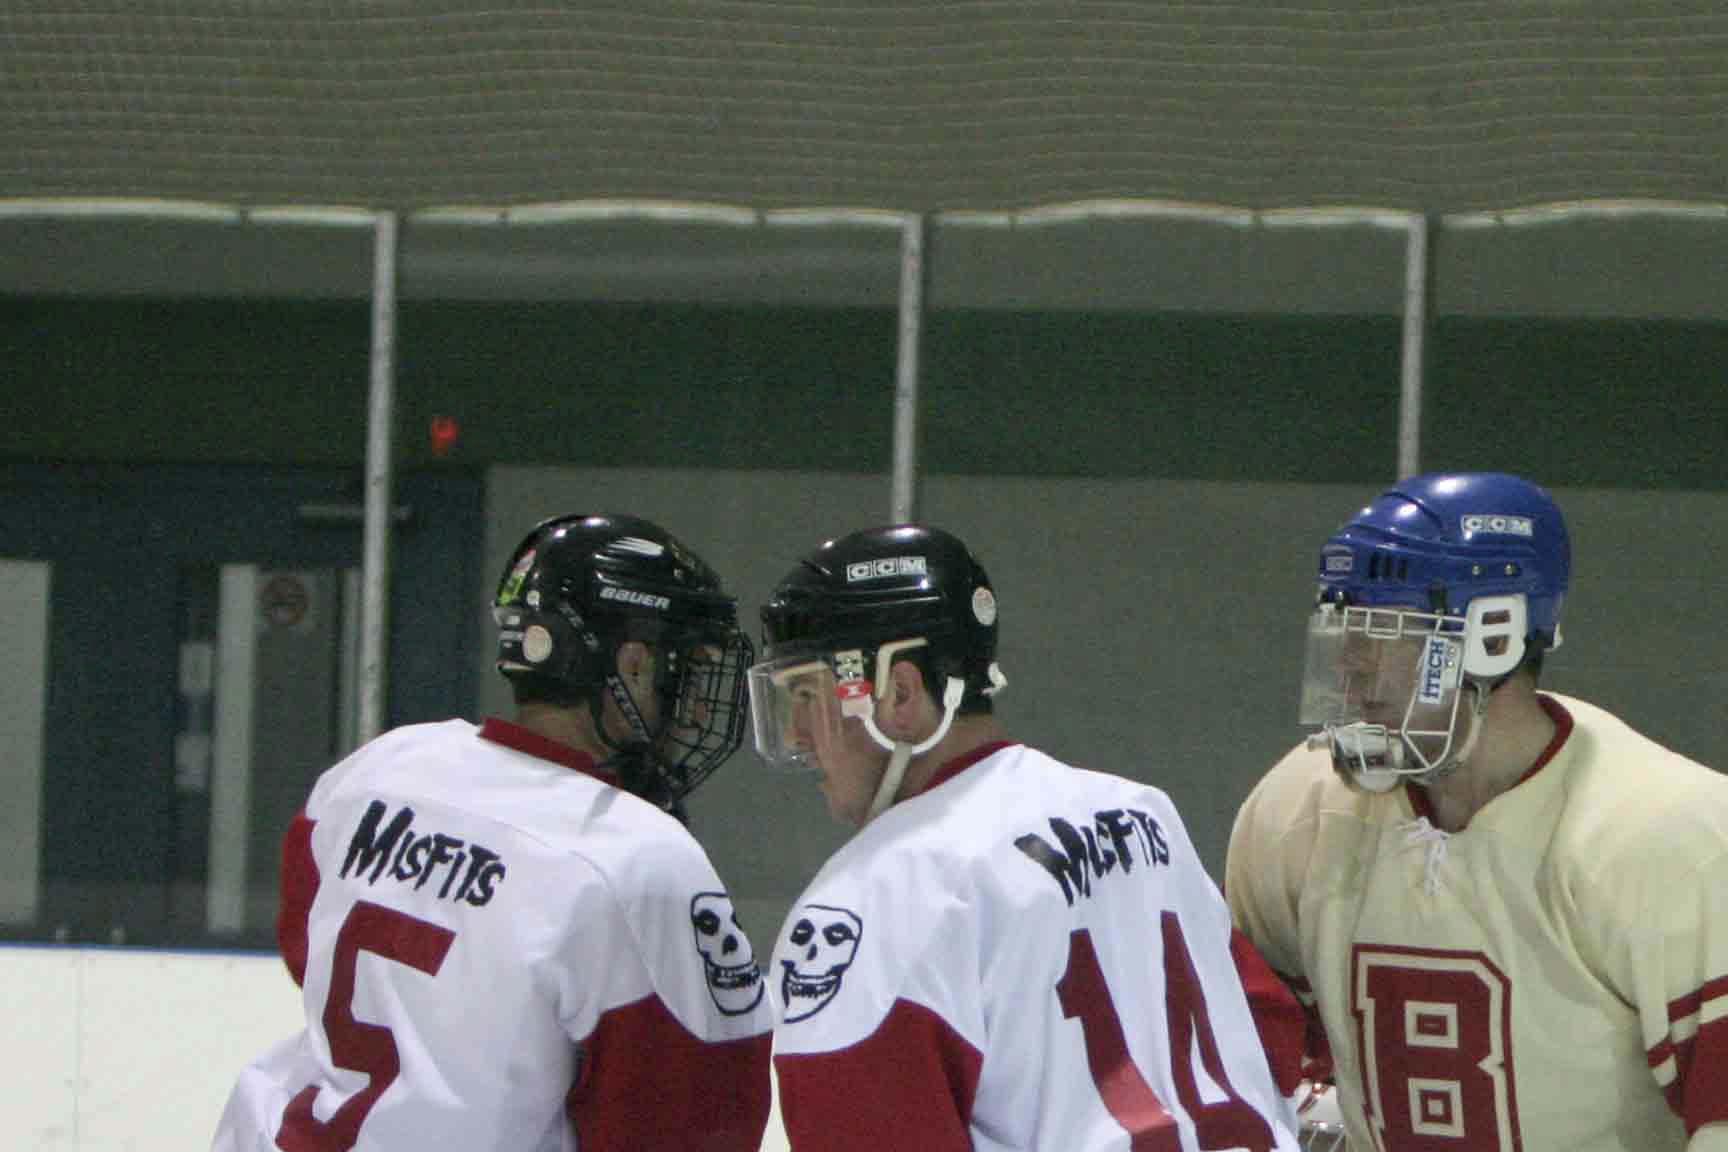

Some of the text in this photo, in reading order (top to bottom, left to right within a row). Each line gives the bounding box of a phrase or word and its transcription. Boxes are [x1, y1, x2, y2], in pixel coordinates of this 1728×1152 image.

[1461, 514, 1533, 537] CCM
[846, 556, 927, 582] CCM
[600, 586, 671, 608] BAUER
[1423, 640, 1446, 700] ITECH
